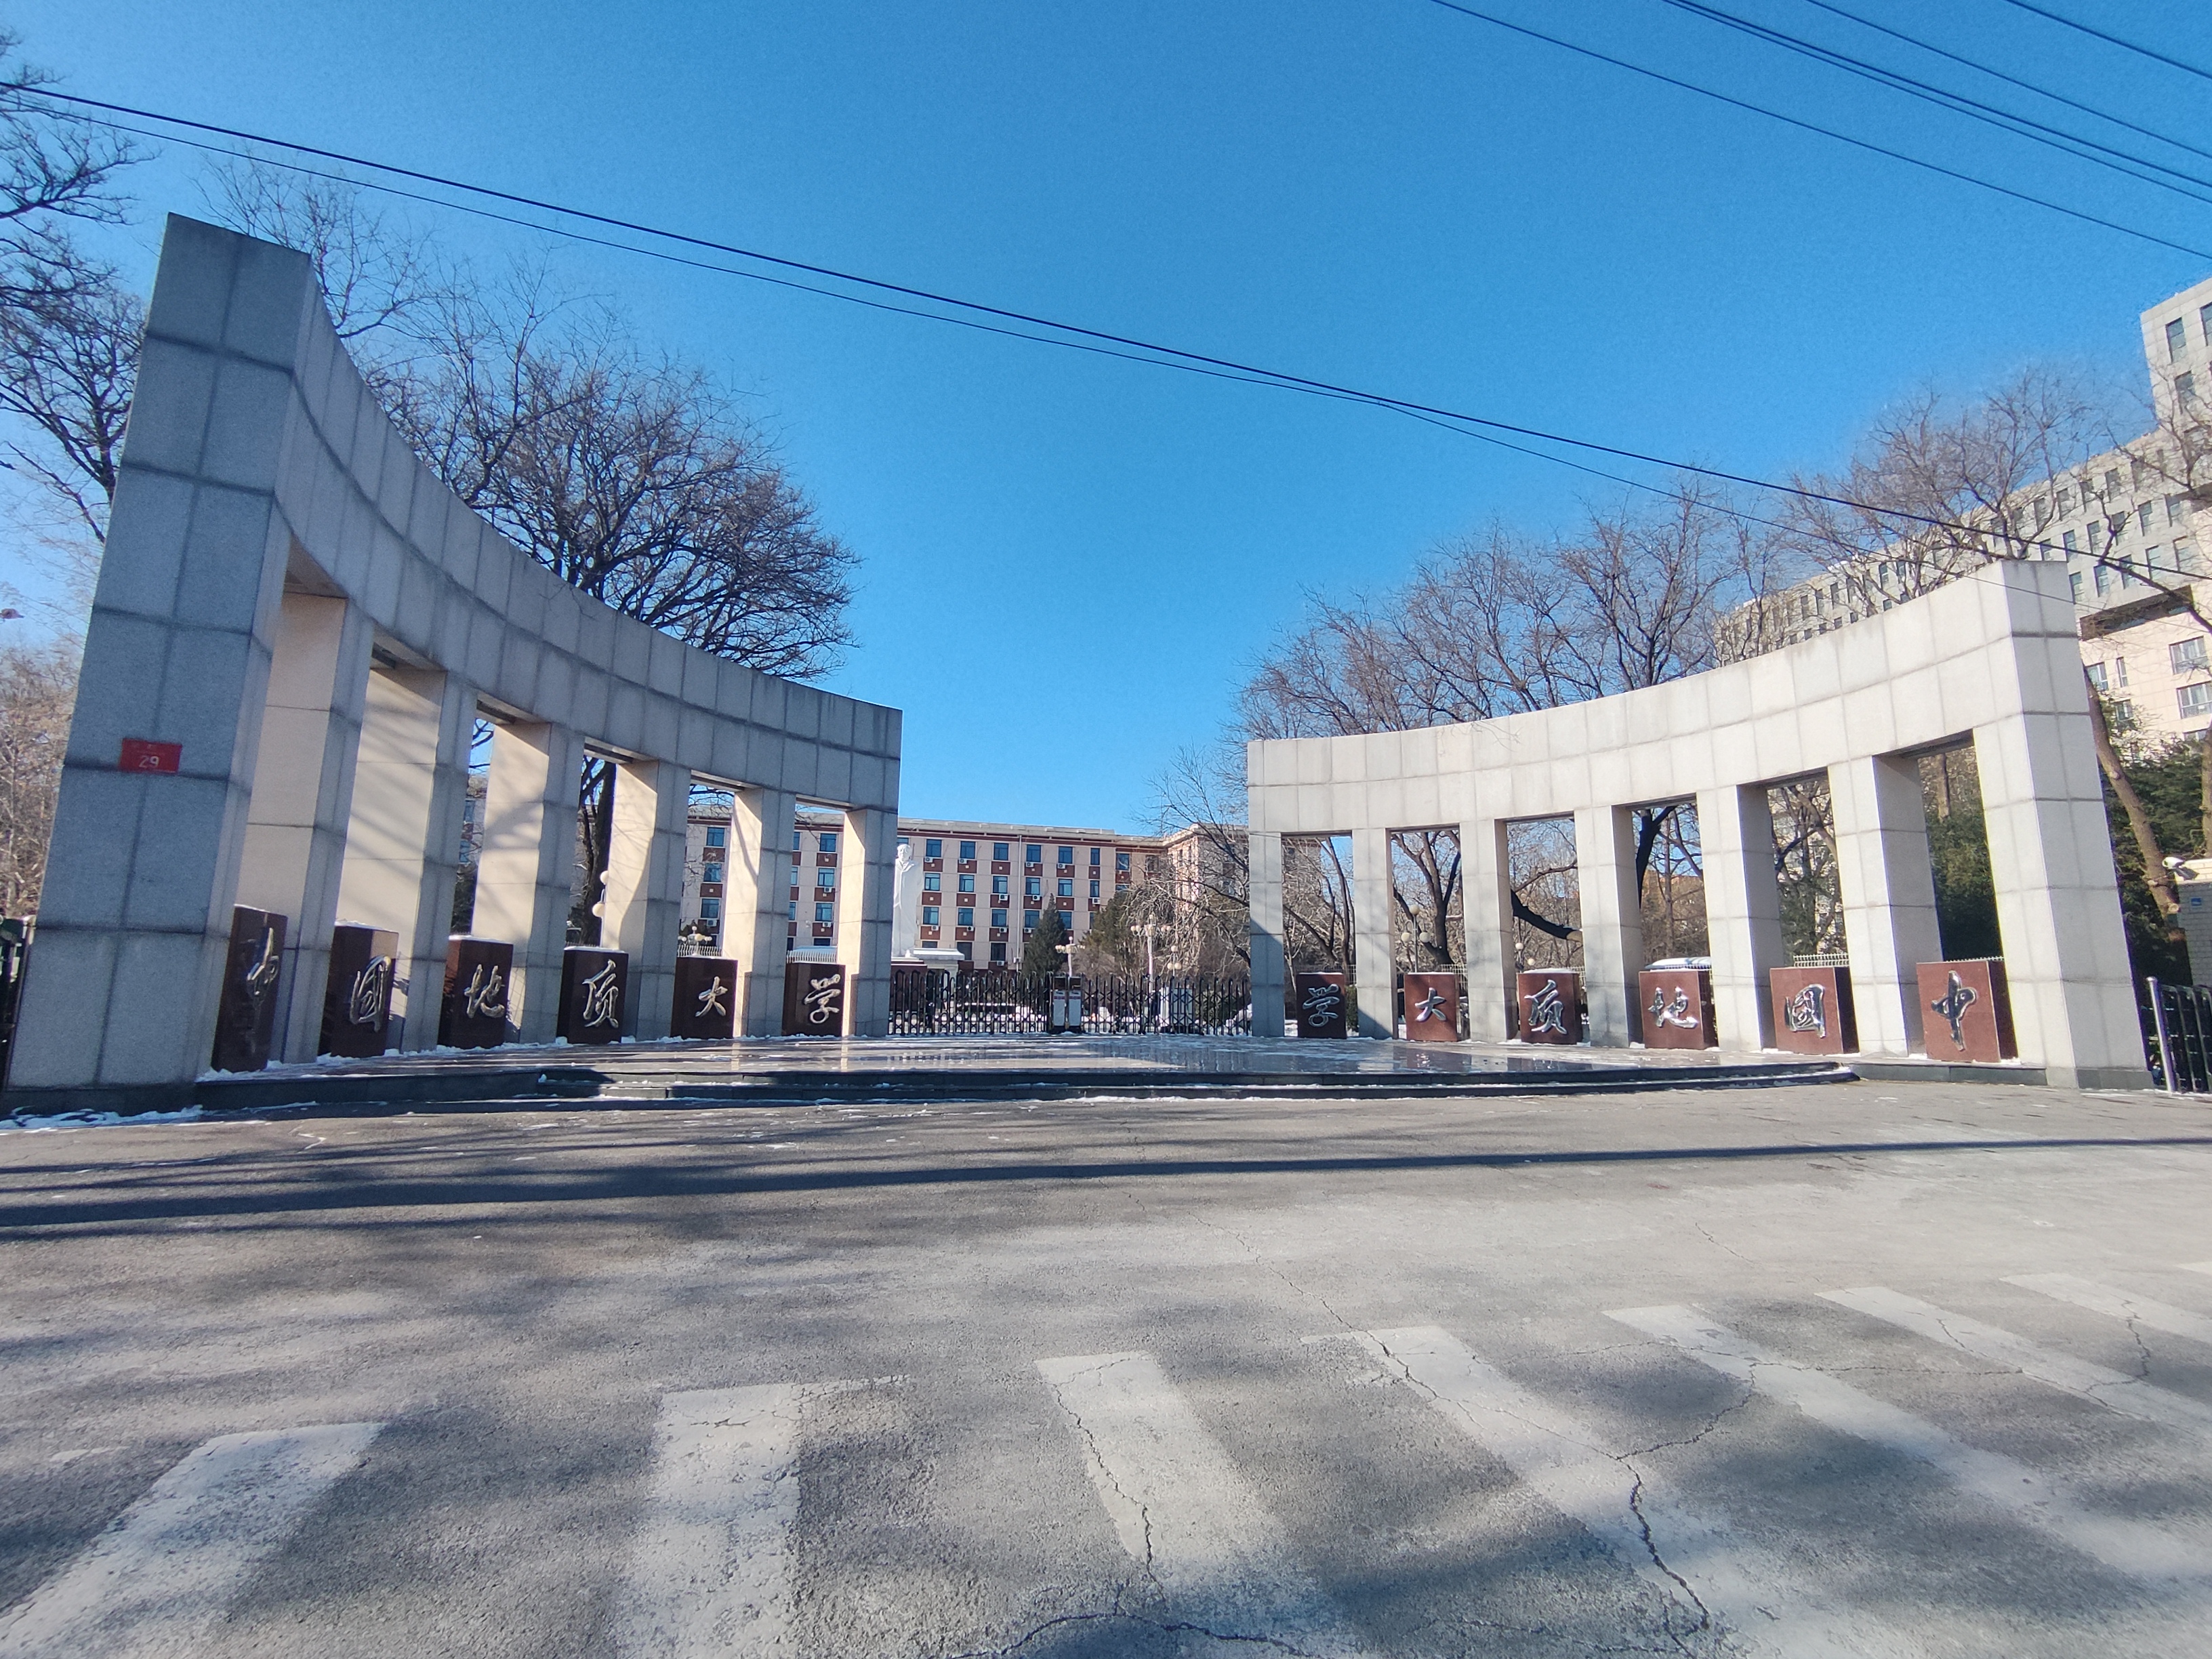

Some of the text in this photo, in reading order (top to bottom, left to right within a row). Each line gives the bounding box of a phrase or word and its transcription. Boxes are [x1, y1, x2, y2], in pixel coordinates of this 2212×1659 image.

[139, 755, 160, 769] 29
[464, 964, 505, 1018] 地
[695, 976, 728, 1017] 大
[804, 974, 841, 1024] 学
[1303, 983, 1340, 1027] 学
[1414, 987, 1447, 1022] 大
[1647, 987, 1699, 1028] 地
[1931, 969, 1977, 1051] 中
